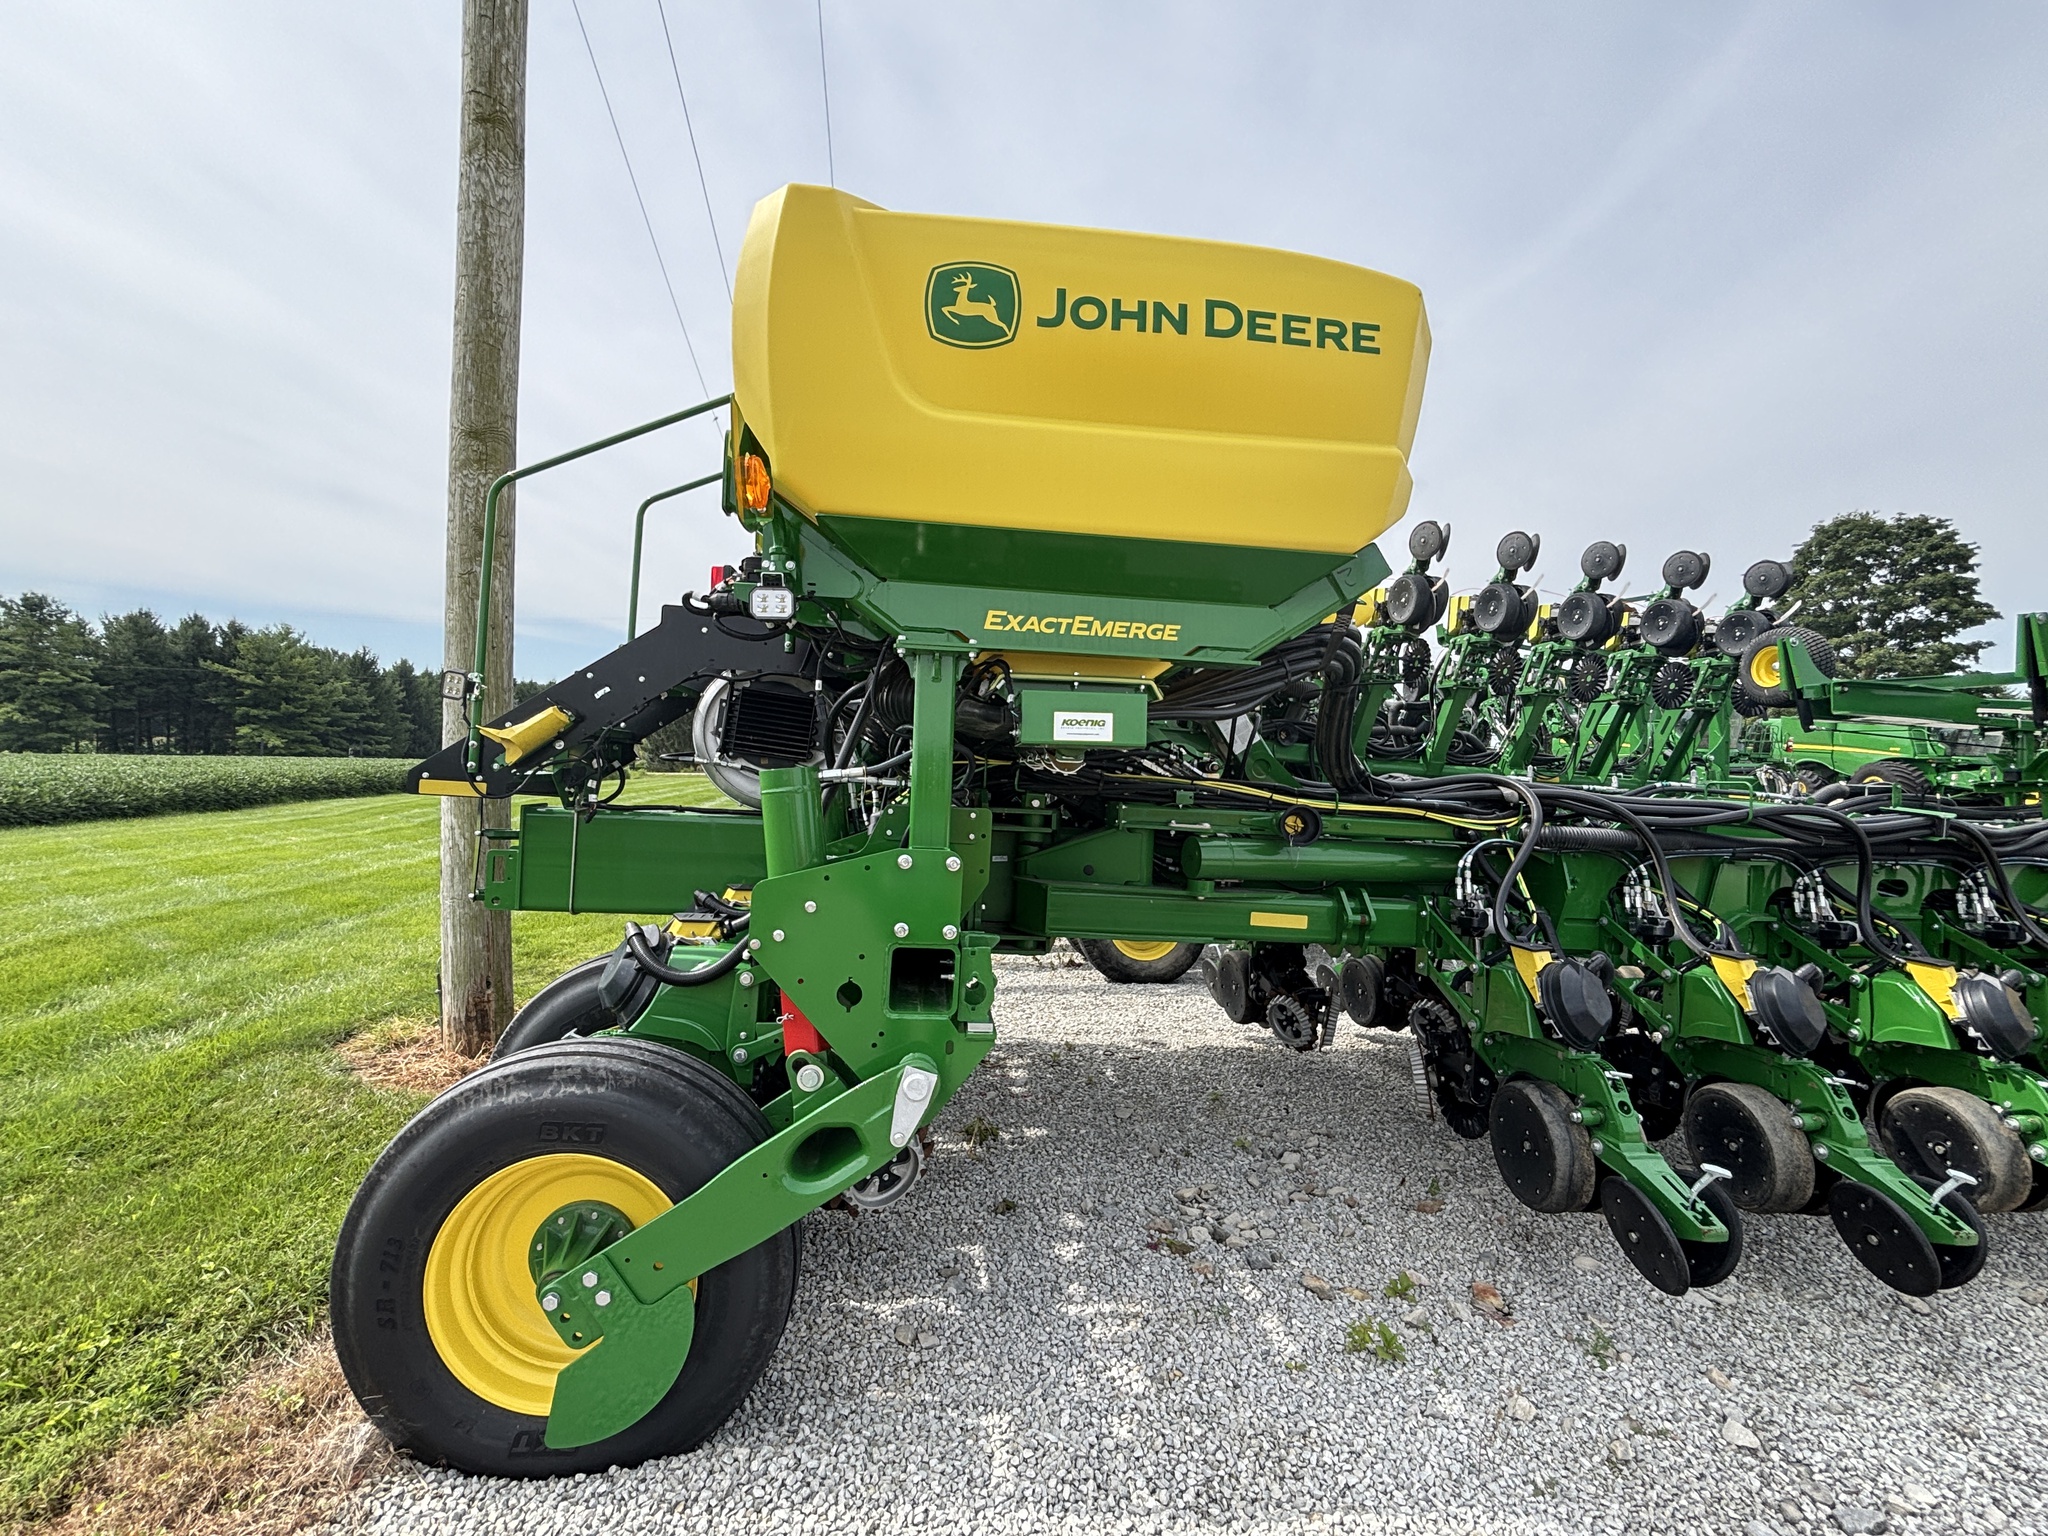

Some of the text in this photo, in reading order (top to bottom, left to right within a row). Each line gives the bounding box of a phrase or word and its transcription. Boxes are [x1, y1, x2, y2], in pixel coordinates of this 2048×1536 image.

[1036, 287, 1381, 355] JOHN DEERE
[983, 609, 1182, 641] EXACTEMERGE
[539, 1124, 604, 1142] BKT
